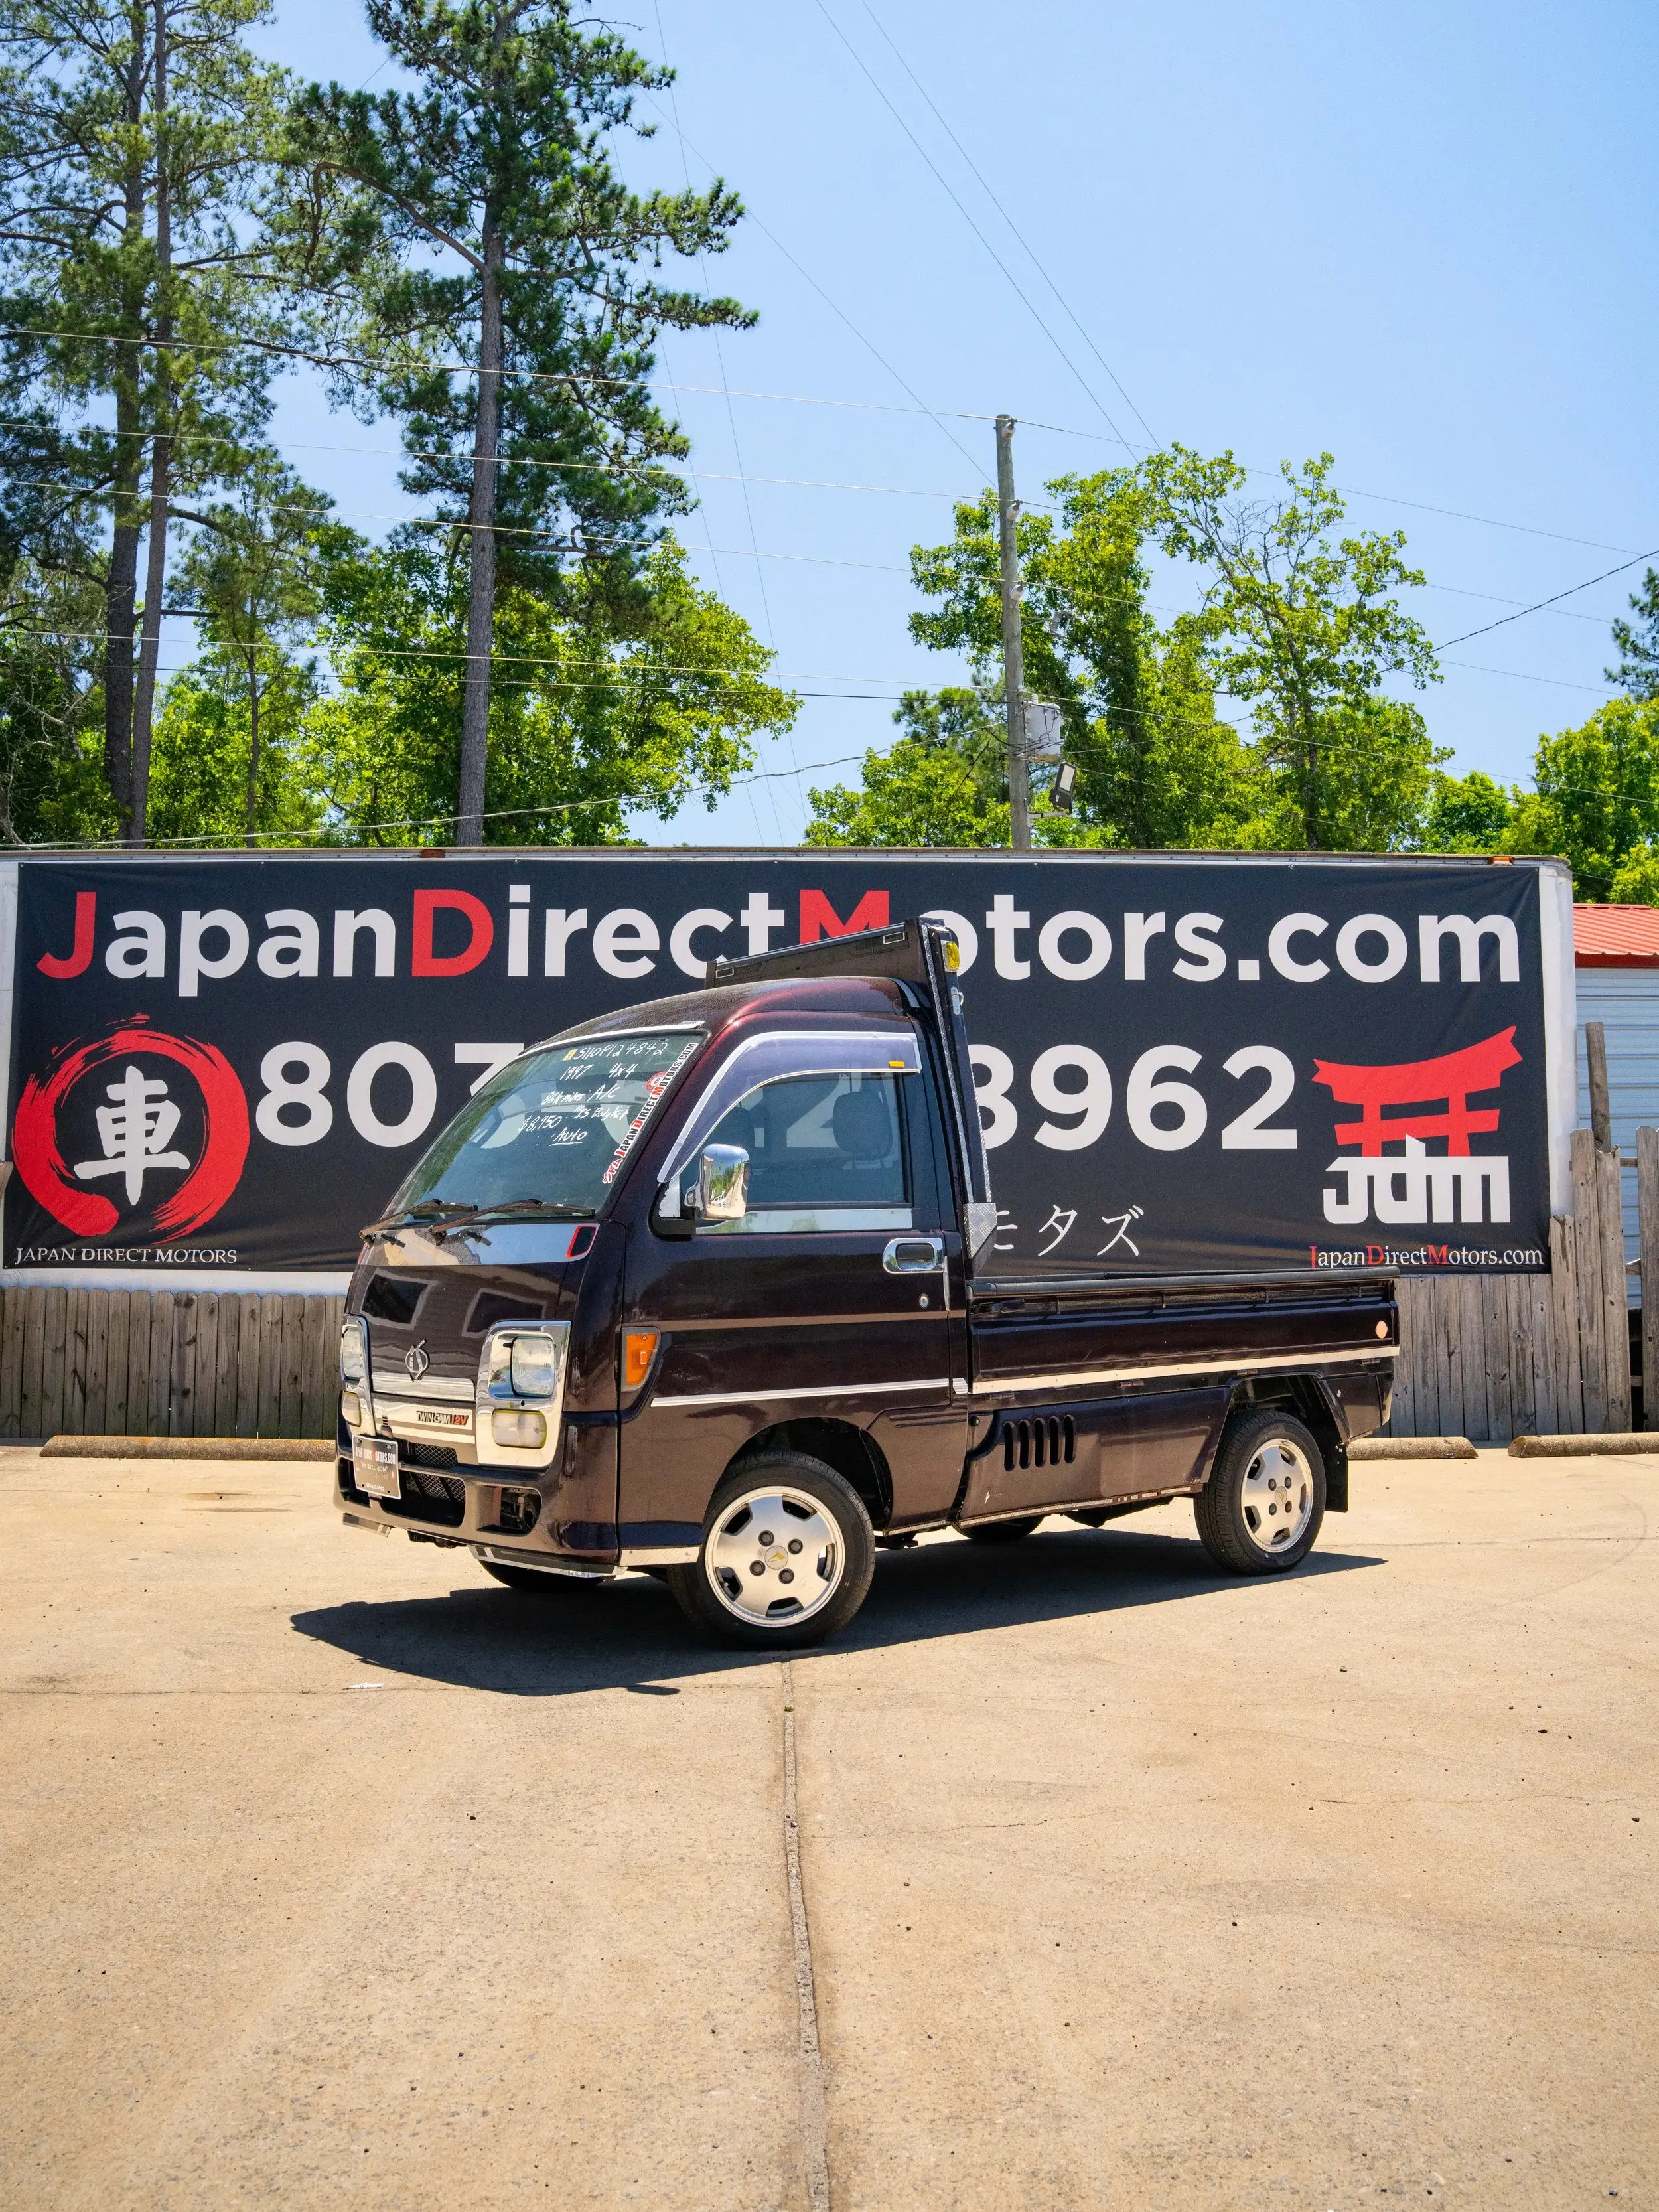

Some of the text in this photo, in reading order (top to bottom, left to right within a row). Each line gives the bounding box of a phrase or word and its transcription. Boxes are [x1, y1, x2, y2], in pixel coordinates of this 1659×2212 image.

[559, 1063, 638, 1081] 1997 4x4
[74, 1065, 190, 1205] 車
[15, 1248, 237, 1264] JAPAN DIRECT MOTORS
[1309, 1244, 1544, 1268] JapanDirectMotors.com
[451, 1415, 469, 1426] 12V
